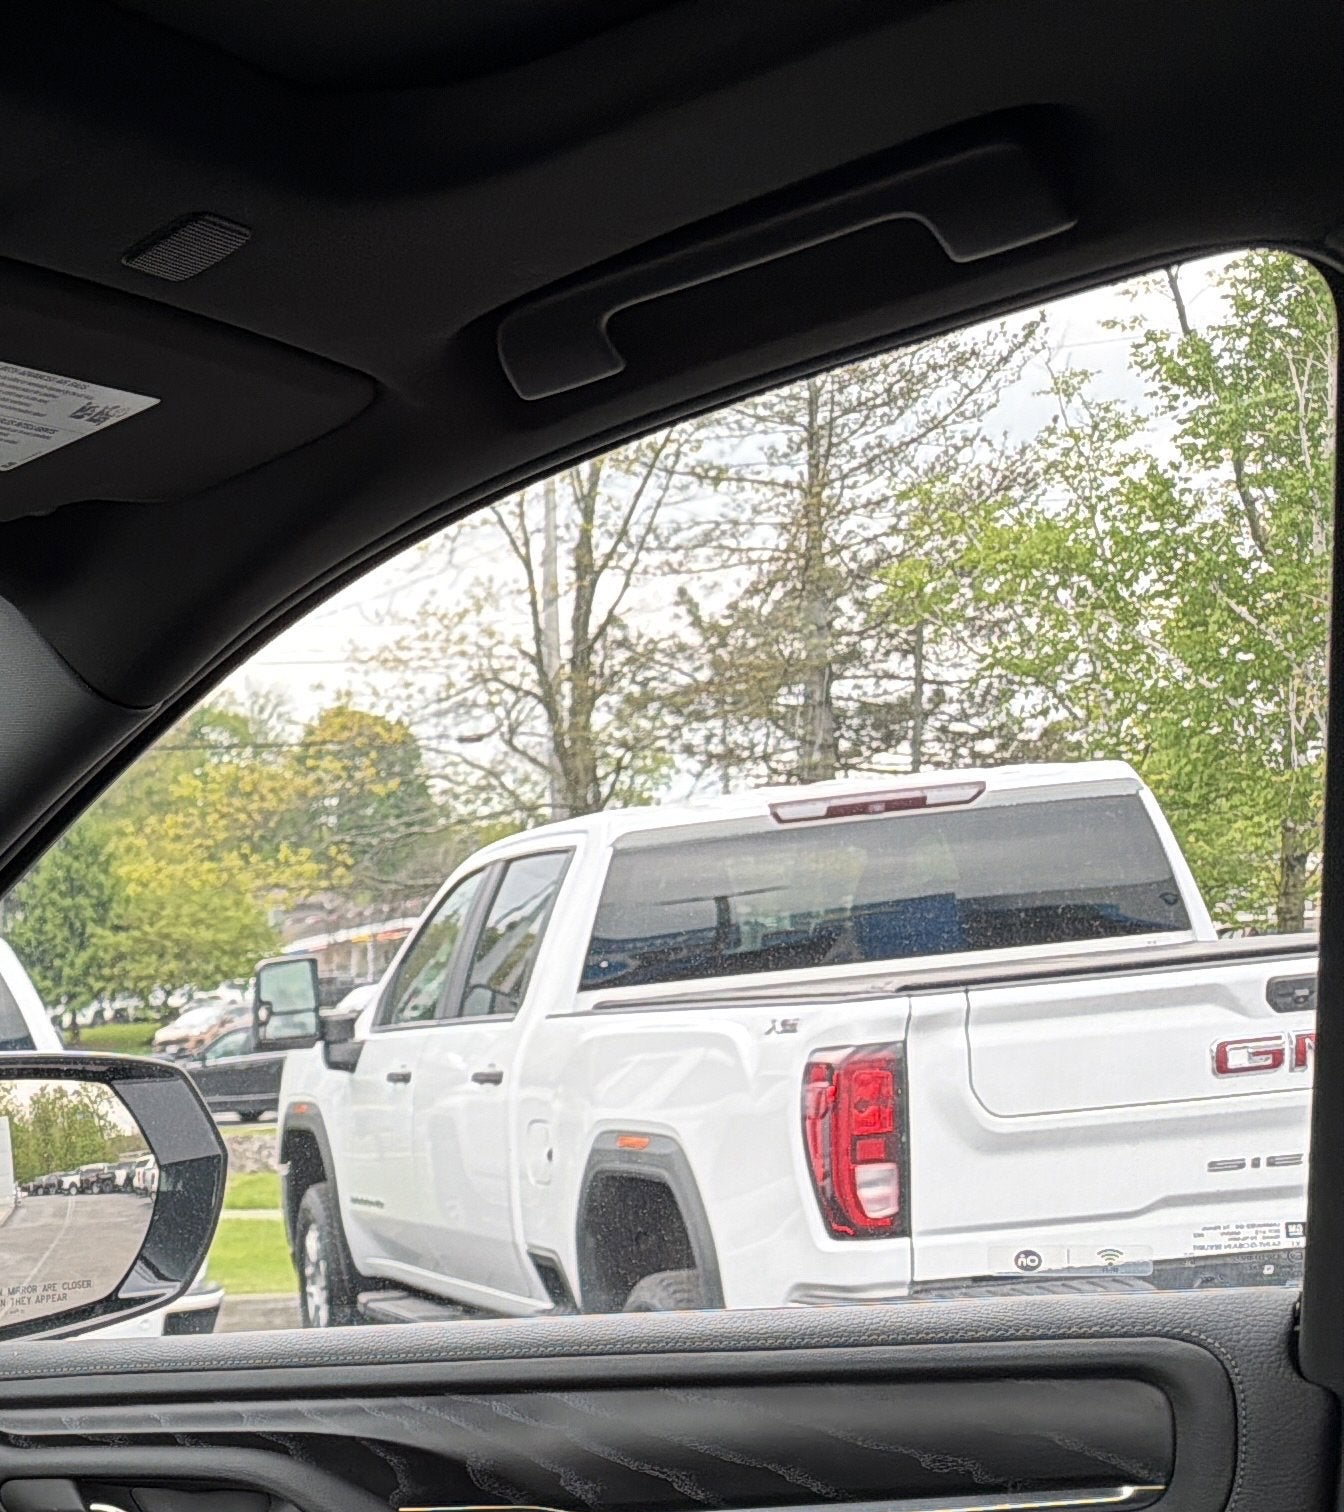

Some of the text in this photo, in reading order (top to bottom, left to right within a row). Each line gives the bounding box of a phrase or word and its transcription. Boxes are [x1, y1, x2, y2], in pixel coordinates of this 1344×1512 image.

[7, 1284, 38, 1296] MIRROR
[42, 1283, 57, 1293] ARE
[62, 1279, 92, 1289] CLOSER
[10, 1296, 31, 1307] THEY
[34, 1293, 68, 1304] APPEAR
